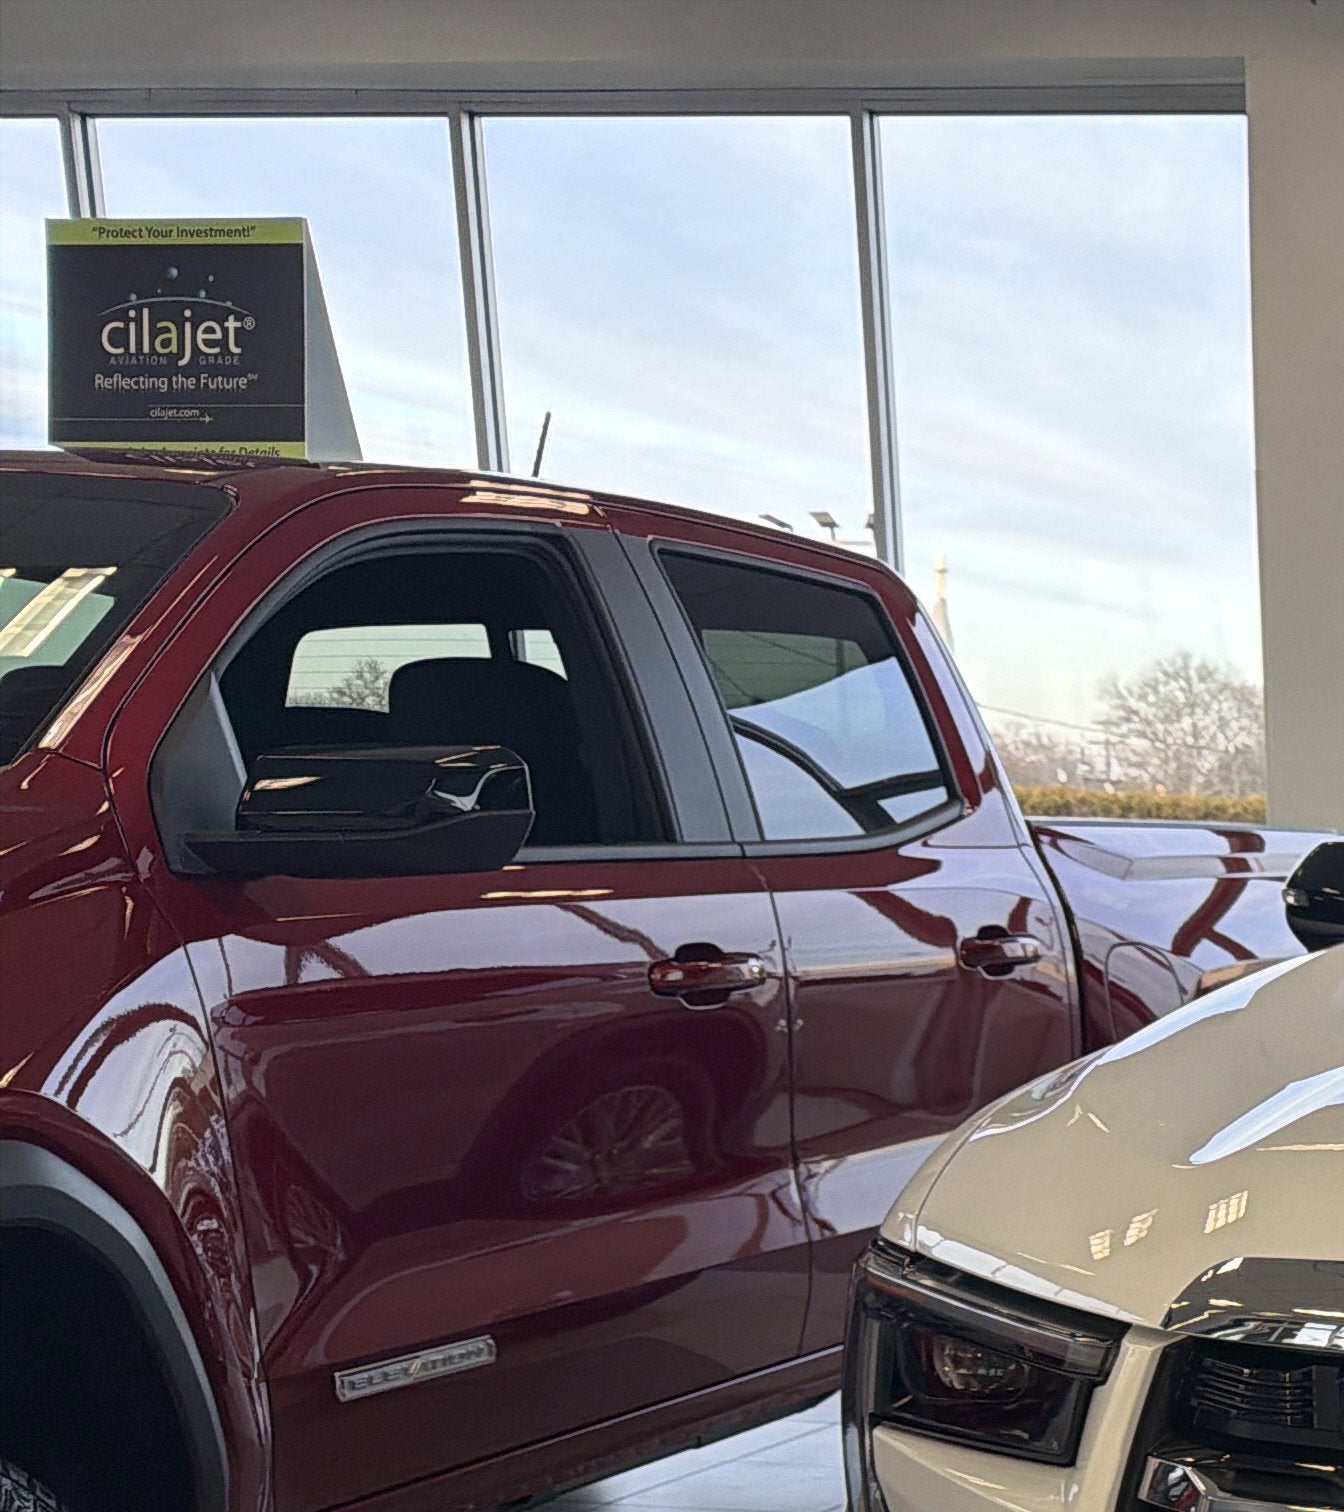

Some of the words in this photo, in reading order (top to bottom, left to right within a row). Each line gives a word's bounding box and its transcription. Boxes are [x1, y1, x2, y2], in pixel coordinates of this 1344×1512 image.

[145, 227, 174, 239] Your
[109, 356, 167, 365] AVIATION
[199, 355, 240, 365] GRADE
[94, 373, 168, 392] Reflecting
[173, 374, 196, 389] the
[150, 407, 200, 419] cilajet.com
